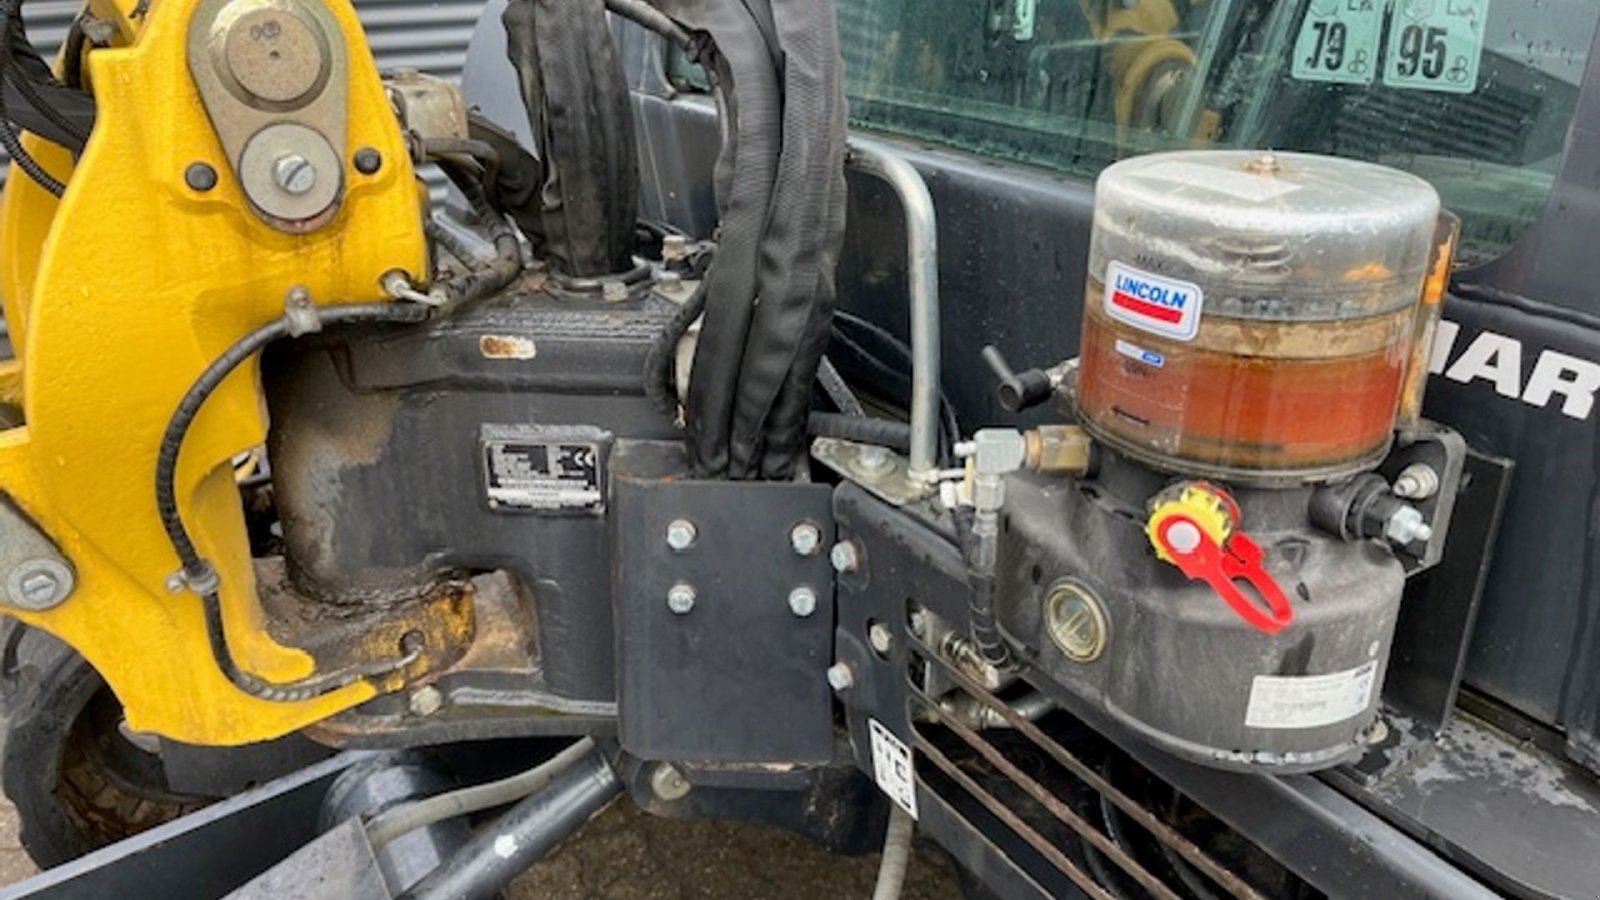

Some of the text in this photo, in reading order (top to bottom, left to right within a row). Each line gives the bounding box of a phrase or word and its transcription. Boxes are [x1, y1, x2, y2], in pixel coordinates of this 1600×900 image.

[1305, 21, 1347, 71] 79
[1397, 25, 1448, 79] 95
[1115, 274, 1187, 310] LINCOLN
